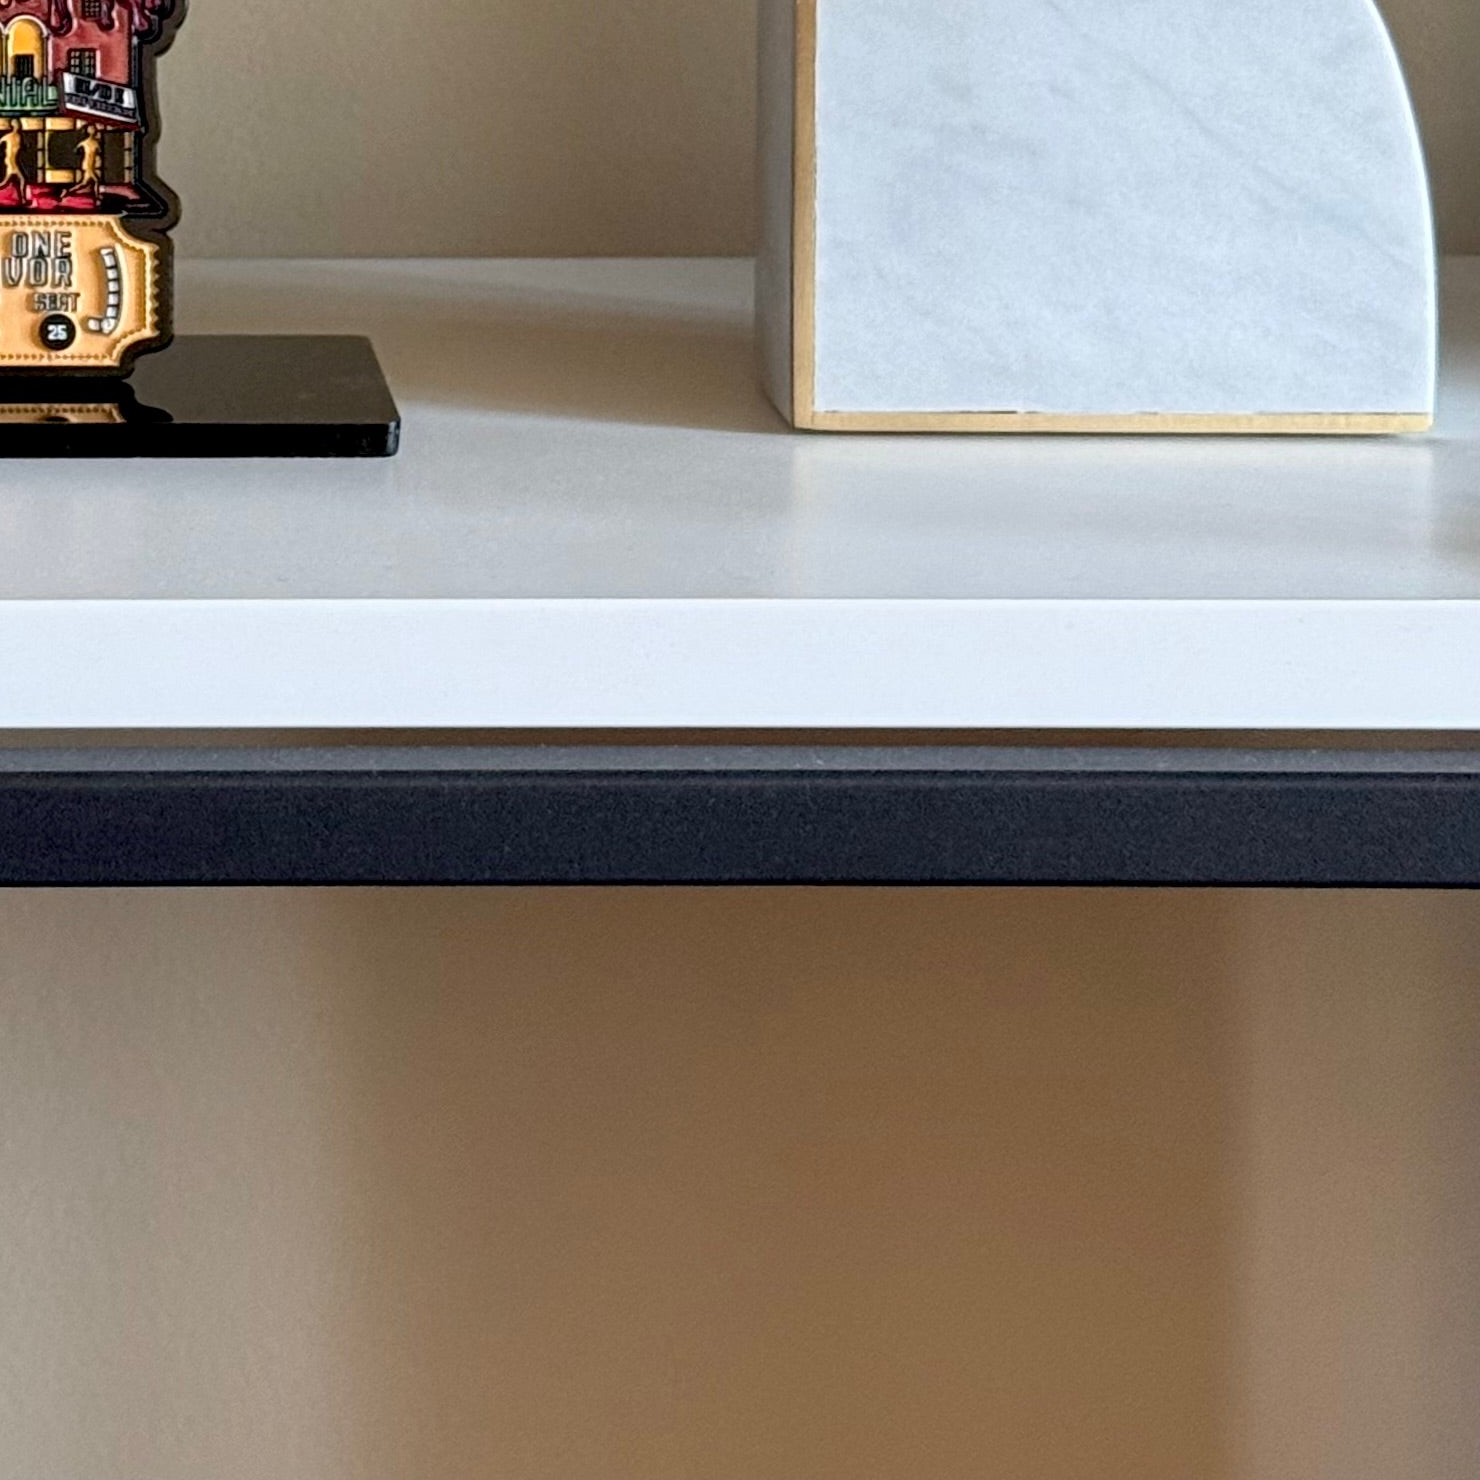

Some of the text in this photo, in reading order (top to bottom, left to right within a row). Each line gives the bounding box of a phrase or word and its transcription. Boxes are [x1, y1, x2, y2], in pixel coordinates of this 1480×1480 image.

[11, 231, 72, 259] ONE
[34, 292, 81, 312] SEAT
[47, 324, 68, 341] 25
